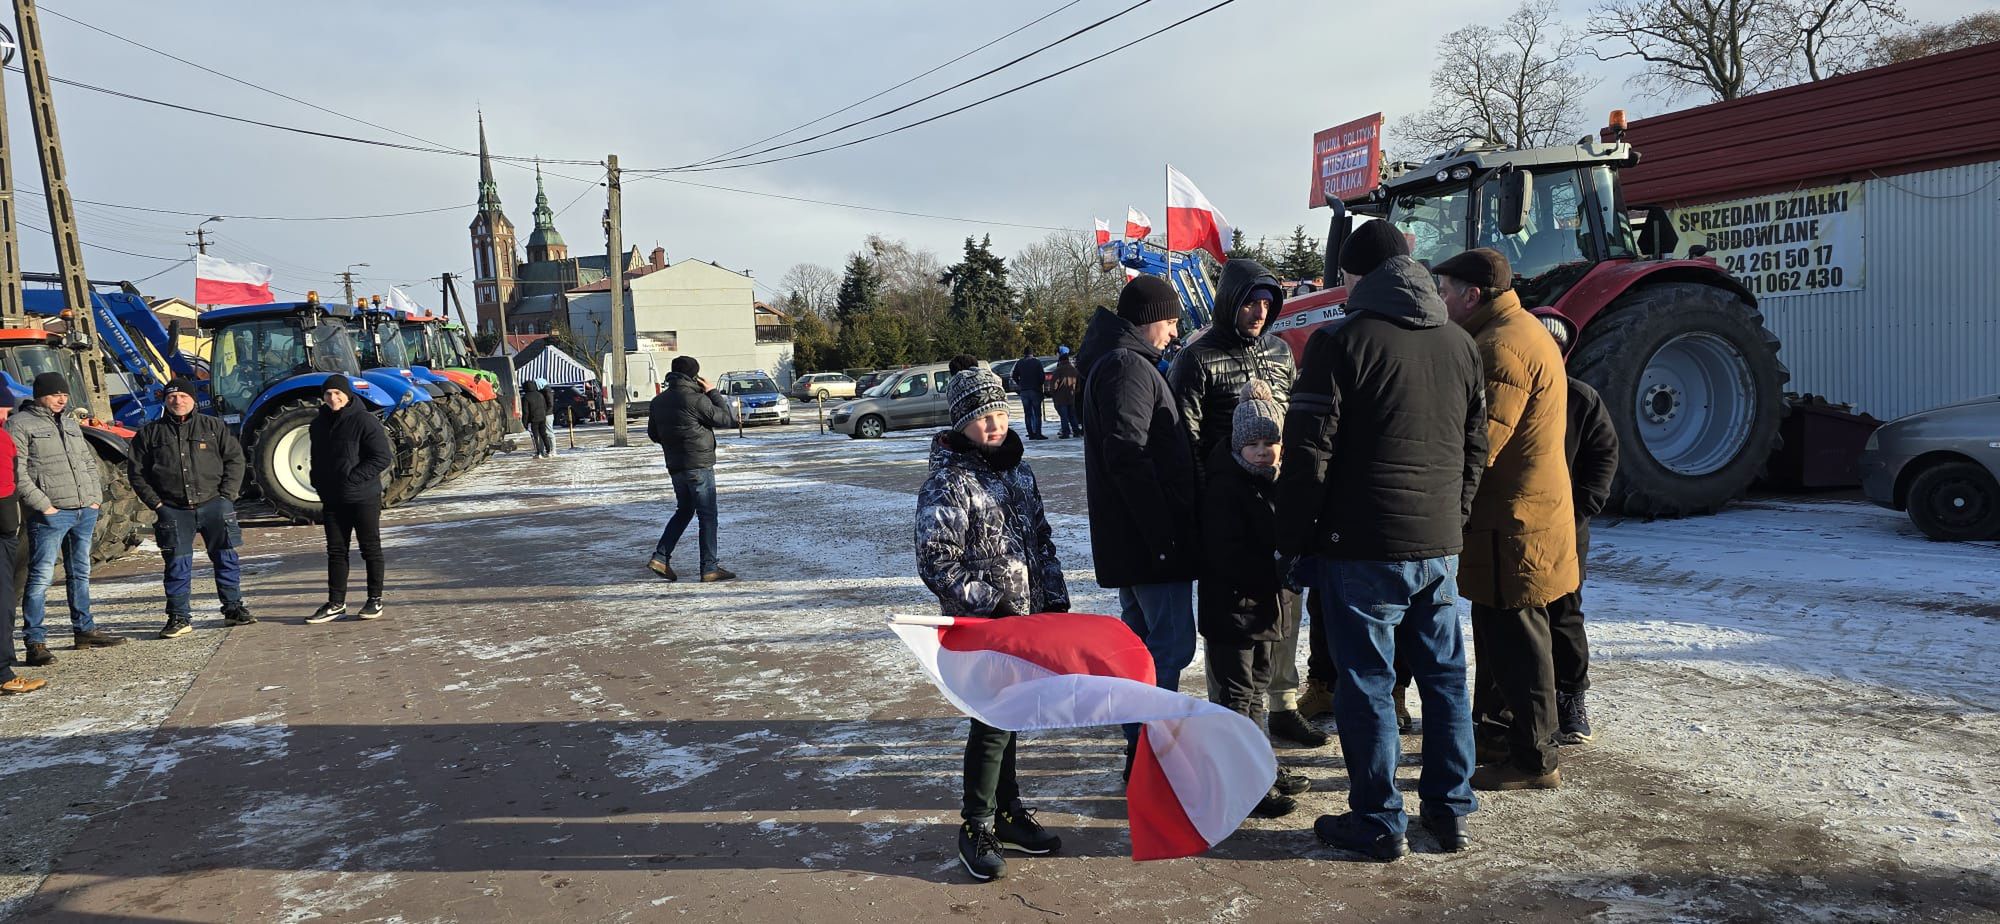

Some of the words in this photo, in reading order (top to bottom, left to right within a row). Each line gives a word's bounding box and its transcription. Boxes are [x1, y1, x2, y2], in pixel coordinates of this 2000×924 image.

[1343, 125, 1377, 147] POLITYKA
[1327, 148, 1364, 174] NISZCZY
[1324, 171, 1362, 194] ROLNIKA
[1679, 202, 1770, 232] SPRZEDAM
[1775, 190, 1849, 221] DZIAŁKI
[1706, 219, 1819, 251] BUDOWLANE
[1725, 255, 1746, 274] 24
[1749, 251, 1781, 272] 261
[1785, 247, 1810, 268] 50
[1813, 245, 1833, 265] 17
[1766, 271, 1801, 293] 062
[1805, 266, 1843, 289] 430
[1295, 312, 1308, 327] S
[99, 309, 116, 329] NEW
[113, 329, 143, 366] HOLLAND
